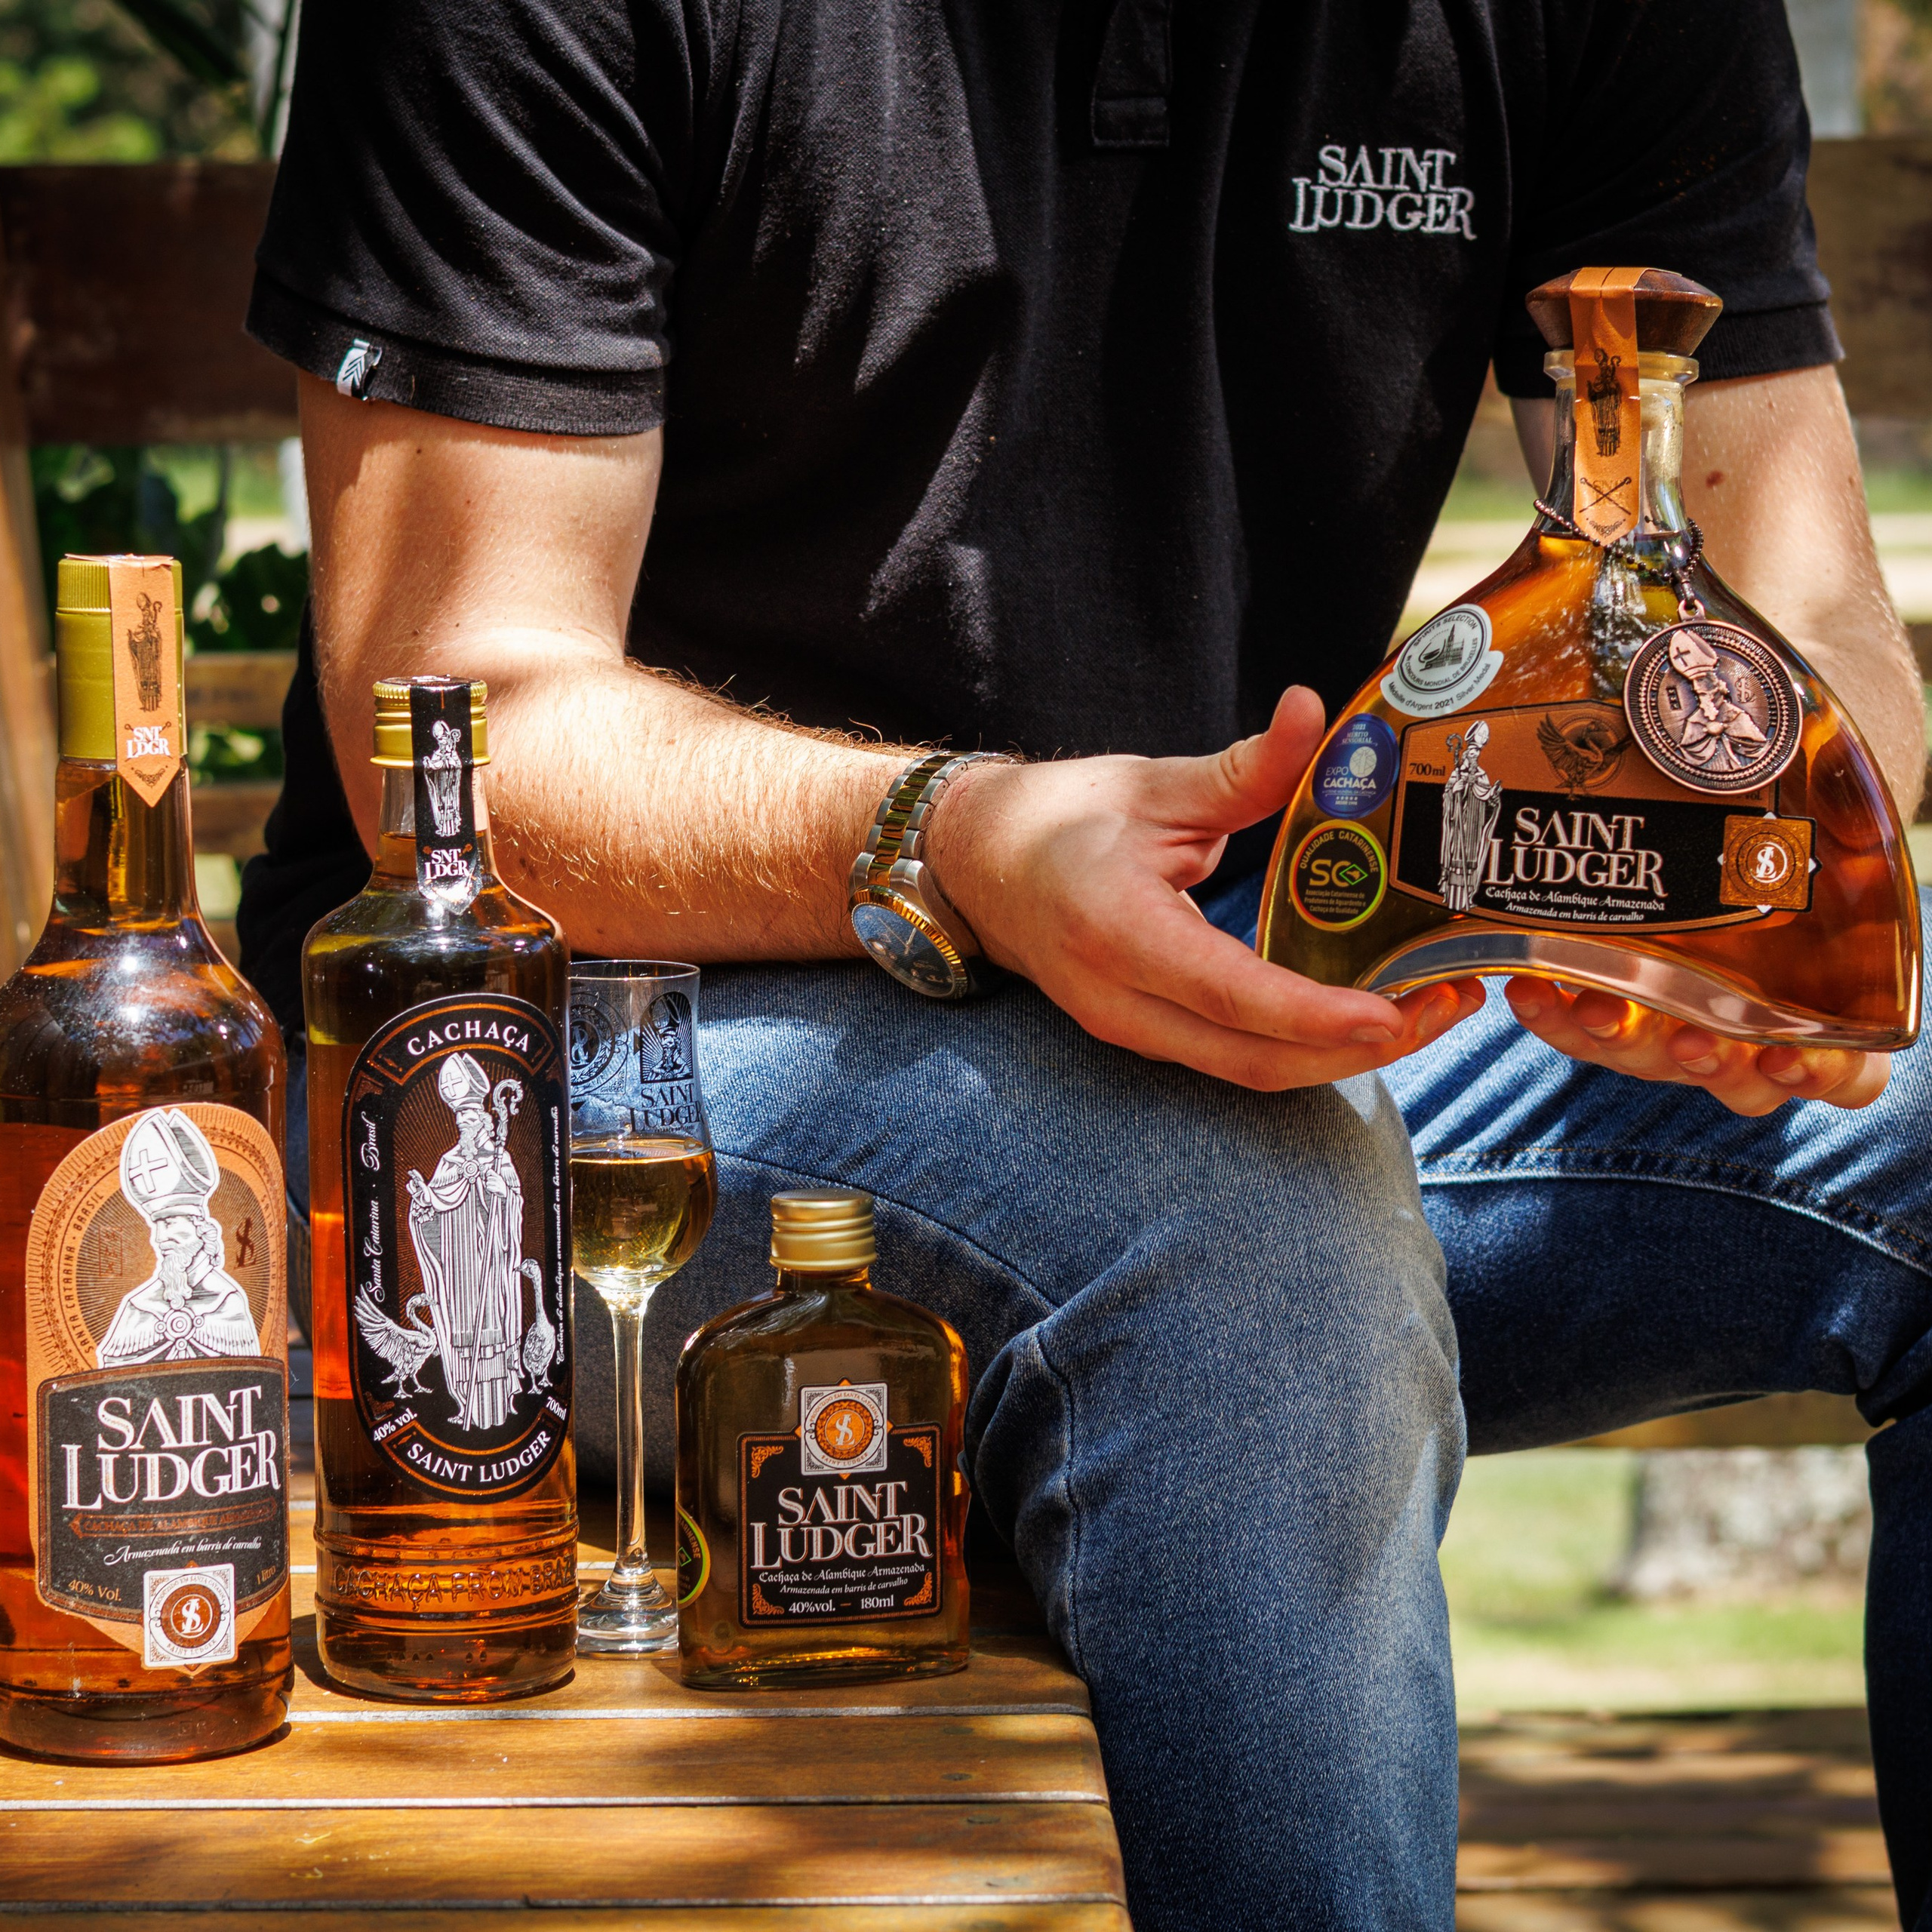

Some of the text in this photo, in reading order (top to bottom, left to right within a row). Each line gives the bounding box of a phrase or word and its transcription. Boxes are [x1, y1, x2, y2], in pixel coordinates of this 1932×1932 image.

[1318, 144, 1457, 192] SAINT
[1288, 177, 1478, 241] LUDGER
[1413, 614, 1478, 647] SPIRITS SELECTION
[1405, 661, 1423, 686] CONCOURS
[1423, 677, 1452, 687] MONDIAL
[1460, 637, 1478, 671] BRUXELLES
[1389, 663, 1491, 712] Médaille d'Argent 2021 Silver Medal
[127, 737, 171, 758] LDGR
[133, 725, 163, 743] SNT
[1323, 777, 1377, 790] CACHAÇA
[1326, 766, 1349, 777] EXPO
[1512, 807, 1645, 853] SAINT
[430, 848, 461, 865] SNT
[1300, 831, 1379, 873] QUALIDADE CATARINENSE
[424, 860, 471, 880] LDGR
[1309, 859, 1352, 888] SC
[1482, 838, 1669, 898] LUDGER
[1485, 885, 1666, 911] Cachaça de Alambique Armazenada
[1505, 902, 1557, 918] Armazenada
[1573, 911, 1597, 921] barris
[1598, 912, 1608, 921] de
[1608, 912, 1644, 921] carvalho
[407, 1020, 530, 1056] CACHAÇA
[641, 1082, 696, 1109] SAINT
[551, 1106, 559, 1144] carvalho
[628, 1100, 705, 1134] LUDGER
[552, 1145, 559, 1157] de
[361, 1111, 386, 1303] Santa Catarina Brasil
[555, 1188, 561, 1201] em
[553, 1203, 561, 1260] armazenada
[63, 1192, 104, 1355] SANTA CATARINA BRASIL
[555, 1261, 565, 1308] alambique
[555, 1308, 563, 1321] de
[556, 1322, 565, 1365] Cachaça
[97, 1385, 262, 1451] SAINT
[546, 1396, 567, 1421] 700ml
[860, 1396, 879, 1419] CATARINA
[373, 1407, 417, 1442] 40% vol.
[60, 1429, 281, 1510] LUDGER
[407, 1430, 552, 1483] SAINT LUDGER
[821, 1452, 869, 1466] SAINT LUDGER
[778, 1481, 908, 1526] SAINT
[83, 1521, 137, 1534] CACHAÇA
[157, 1515, 218, 1531] ALAMBIQUE
[103, 1540, 180, 1566] Armazenada
[181, 1545, 195, 1554] em
[195, 1538, 222, 1552] barris
[222, 1537, 233, 1550] de
[749, 1513, 934, 1570] LUDGER
[261, 1564, 276, 1583] litro
[334, 1563, 444, 1611] CACHAÇA
[451, 1567, 524, 1602] FROM
[758, 1561, 925, 1585] Cachaça de Alambique Armazenada
[780, 1584, 830, 1595] Armazenada
[844, 1583, 866, 1593] barris
[867, 1581, 877, 1592] de
[877, 1577, 909, 1591] carvalho
[68, 1579, 122, 1602] 40% Vol.
[860, 1594, 894, 1610] 180ml
[167, 1642, 187, 1655] SAINT
